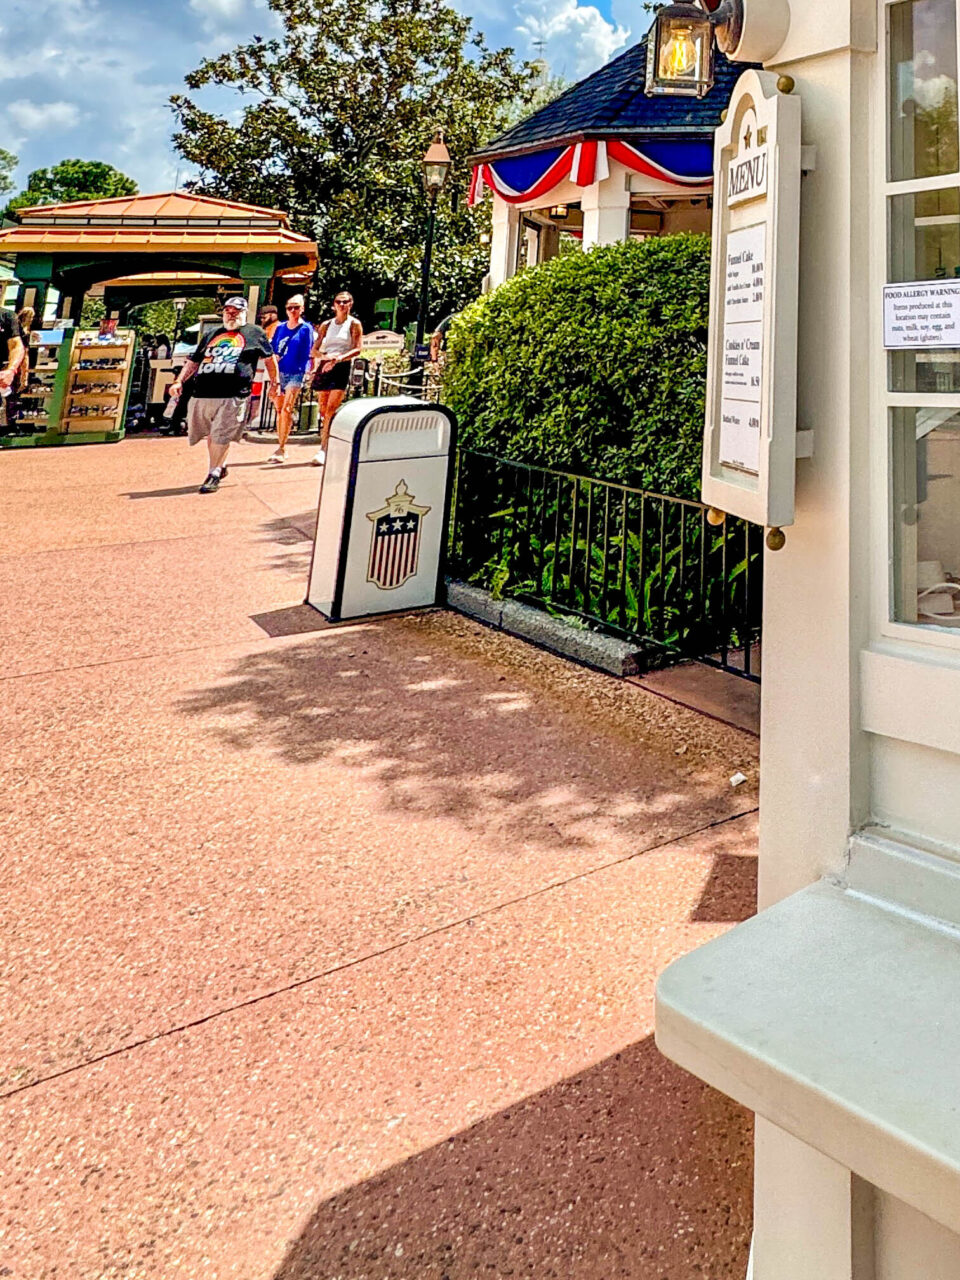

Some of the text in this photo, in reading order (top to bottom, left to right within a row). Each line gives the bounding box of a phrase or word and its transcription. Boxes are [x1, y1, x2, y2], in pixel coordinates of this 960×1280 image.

[728, 153, 766, 197] MENU
[885, 291, 902, 299] FOOD
[903, 289, 929, 298] ALLERGY
[909, 302, 934, 312] produced
[942, 300, 953, 308] this
[895, 313, 916, 321] location
[917, 314, 929, 322] may
[204, 347, 242, 357] LOVE
[198, 363, 236, 374] LOVE
